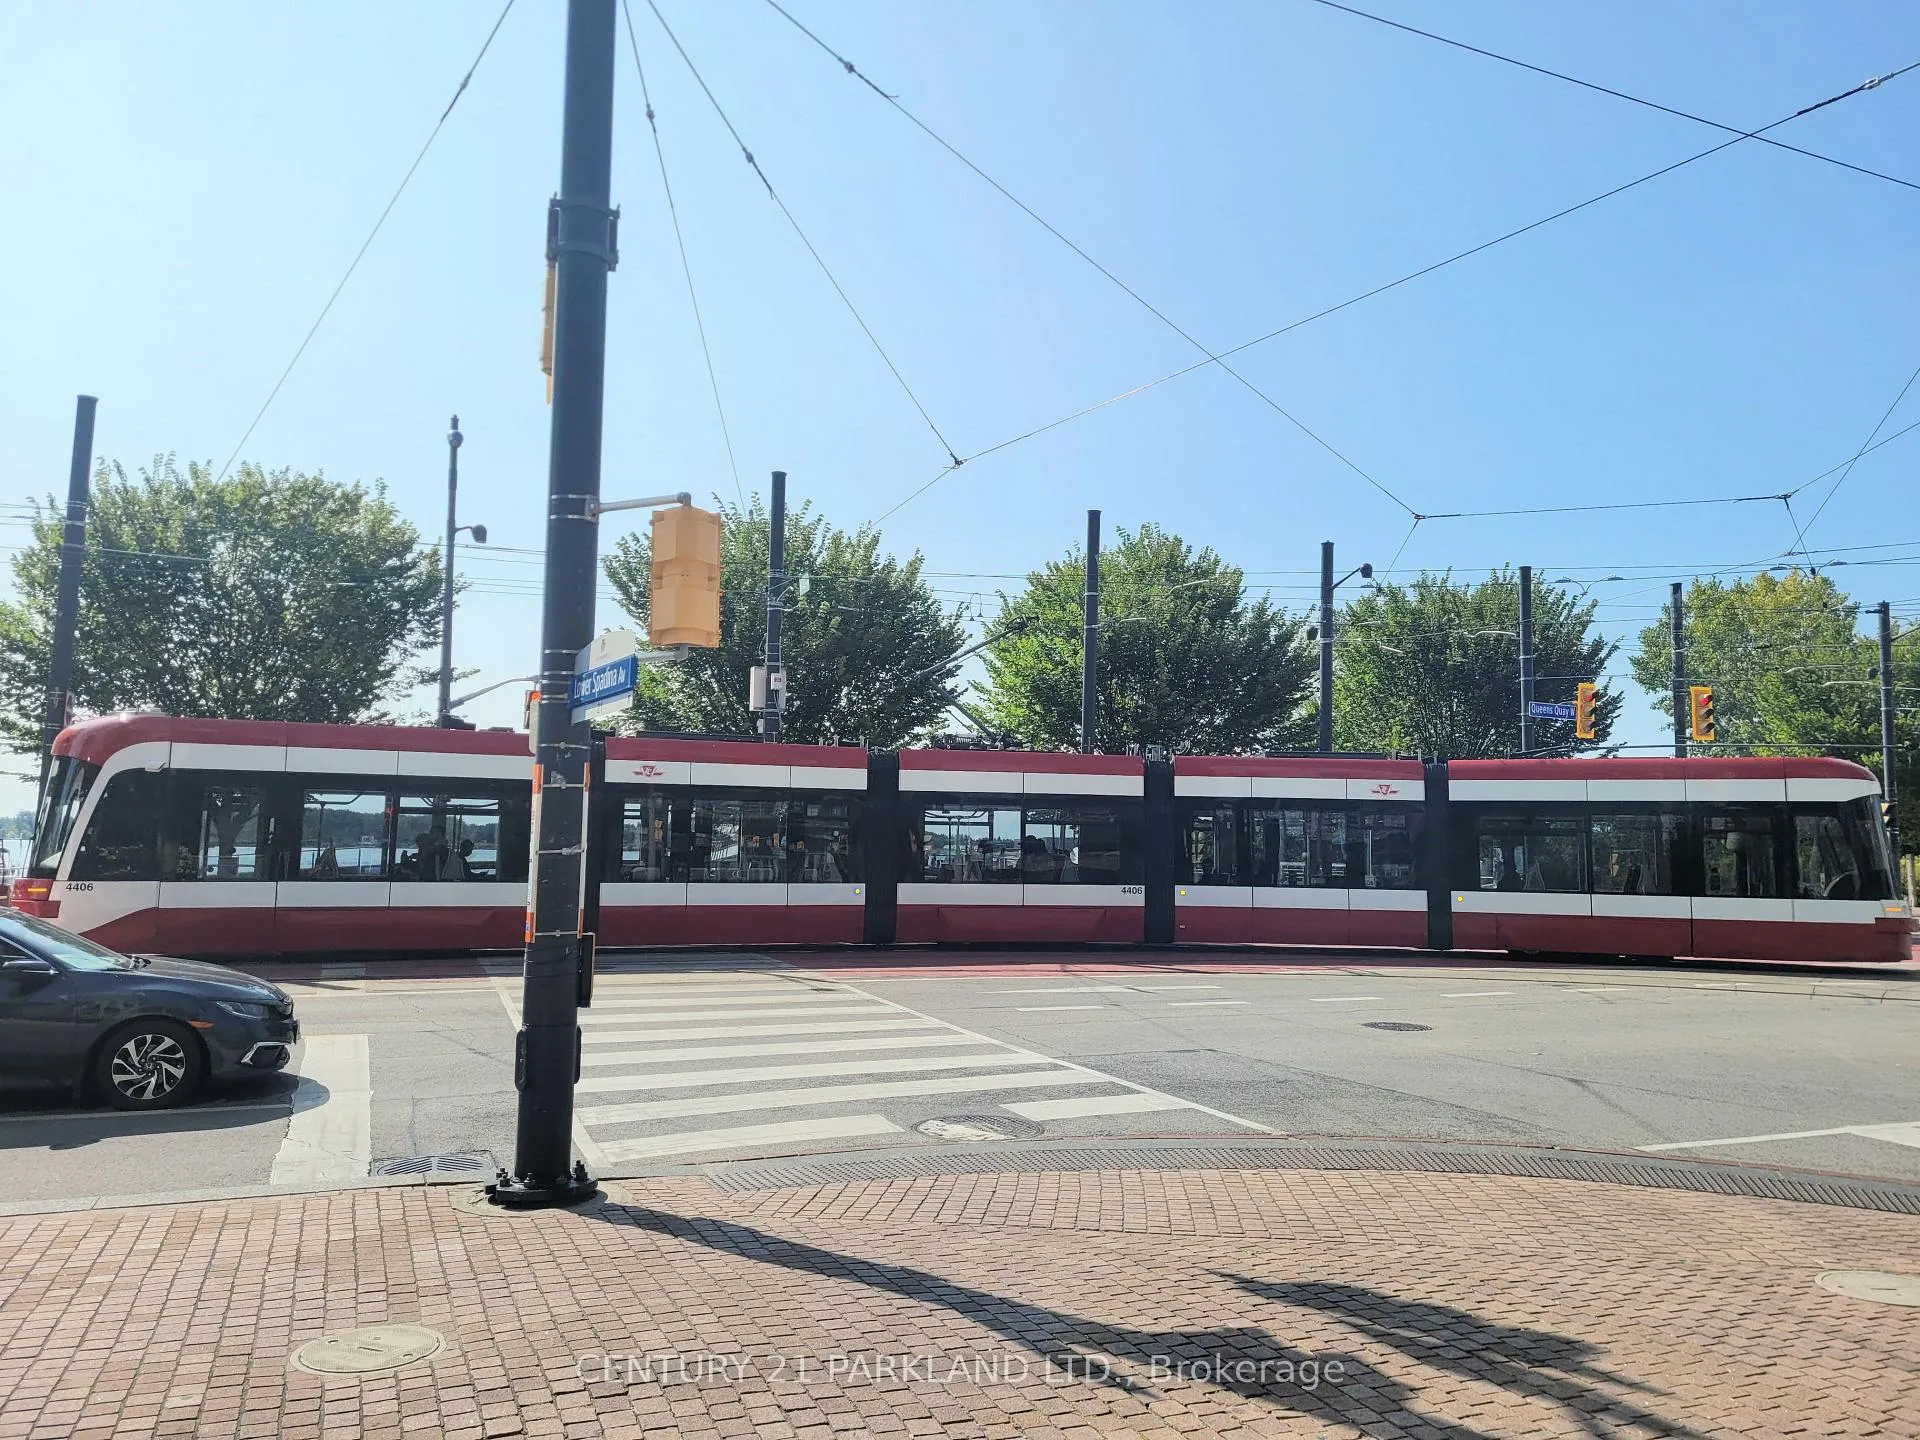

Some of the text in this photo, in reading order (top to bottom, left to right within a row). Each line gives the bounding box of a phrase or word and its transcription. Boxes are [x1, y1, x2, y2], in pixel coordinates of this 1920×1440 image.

[574, 666, 626, 699] Lower Spadina Av
[1531, 703, 1576, 718] Queens Quay W
[65, 882, 94, 892] 4406
[1121, 886, 1143, 895] 4406
